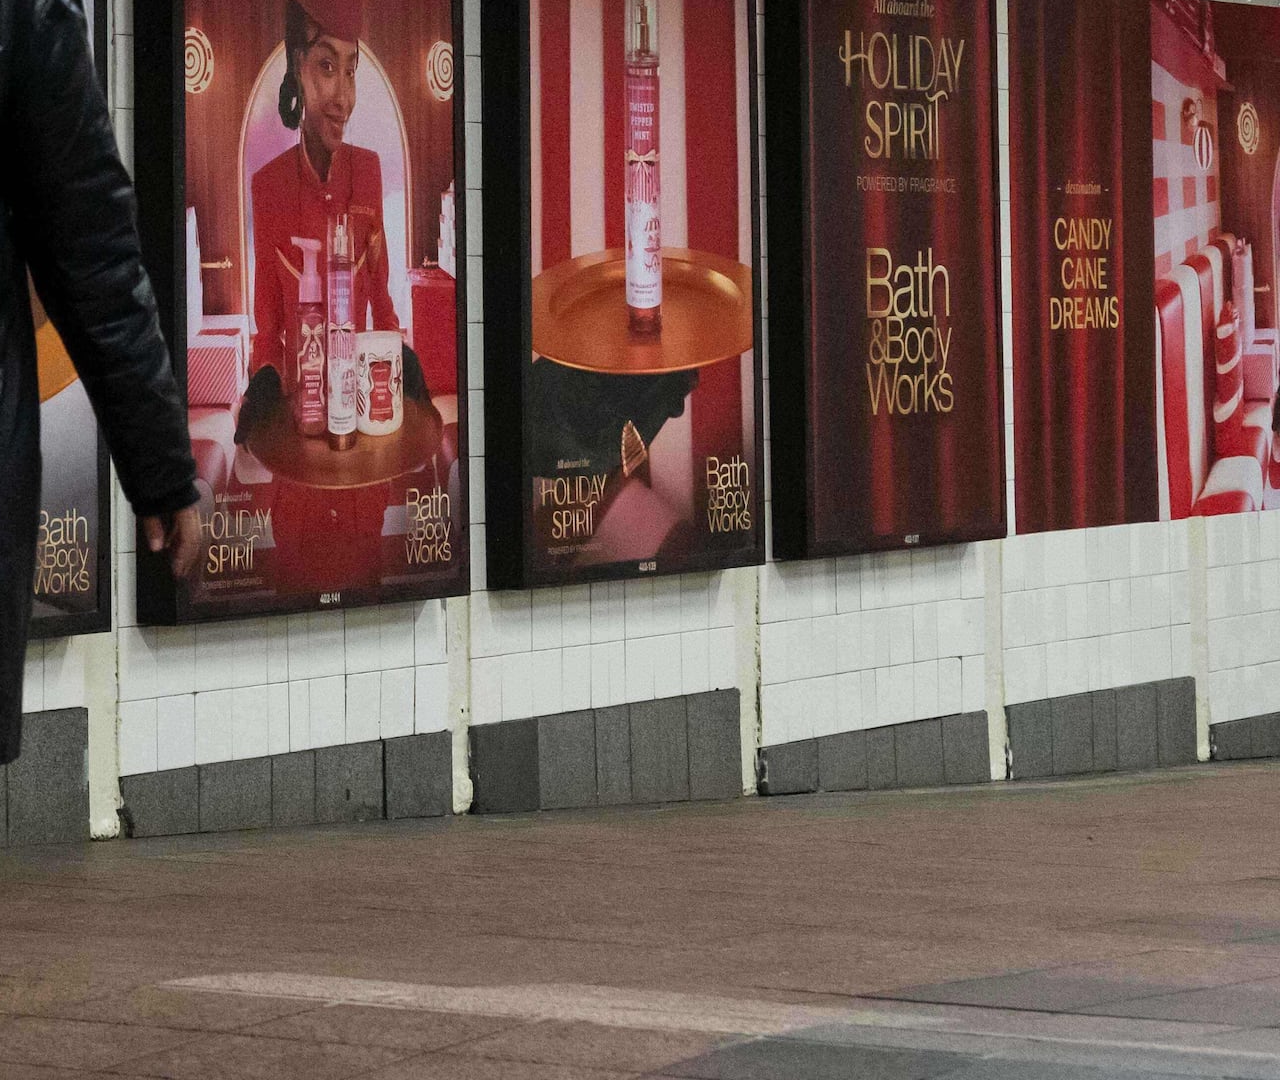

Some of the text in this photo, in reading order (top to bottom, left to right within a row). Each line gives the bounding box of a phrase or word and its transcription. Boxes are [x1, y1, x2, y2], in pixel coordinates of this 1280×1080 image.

[838, 29, 965, 93] HOLIDAY
[864, 90, 949, 160] SPIRIT
[856, 175, 957, 194] POWERED BY FRAGRANCE
[1054, 217, 1112, 250] CANDY
[866, 247, 950, 319] Bath
[1061, 257, 1108, 290] CANE
[1050, 295, 1119, 330] DREAMS
[866, 361, 954, 416] Works
[706, 455, 749, 489] Bath
[406, 486, 450, 520] Bath
[539, 473, 607, 507] HOLIDAY
[197, 508, 271, 540] HOLIDAY
[551, 500, 598, 539] SPIRIT
[707, 507, 752, 533] Works
[207, 535, 260, 574] SPIRIT
[405, 538, 452, 564] Works
